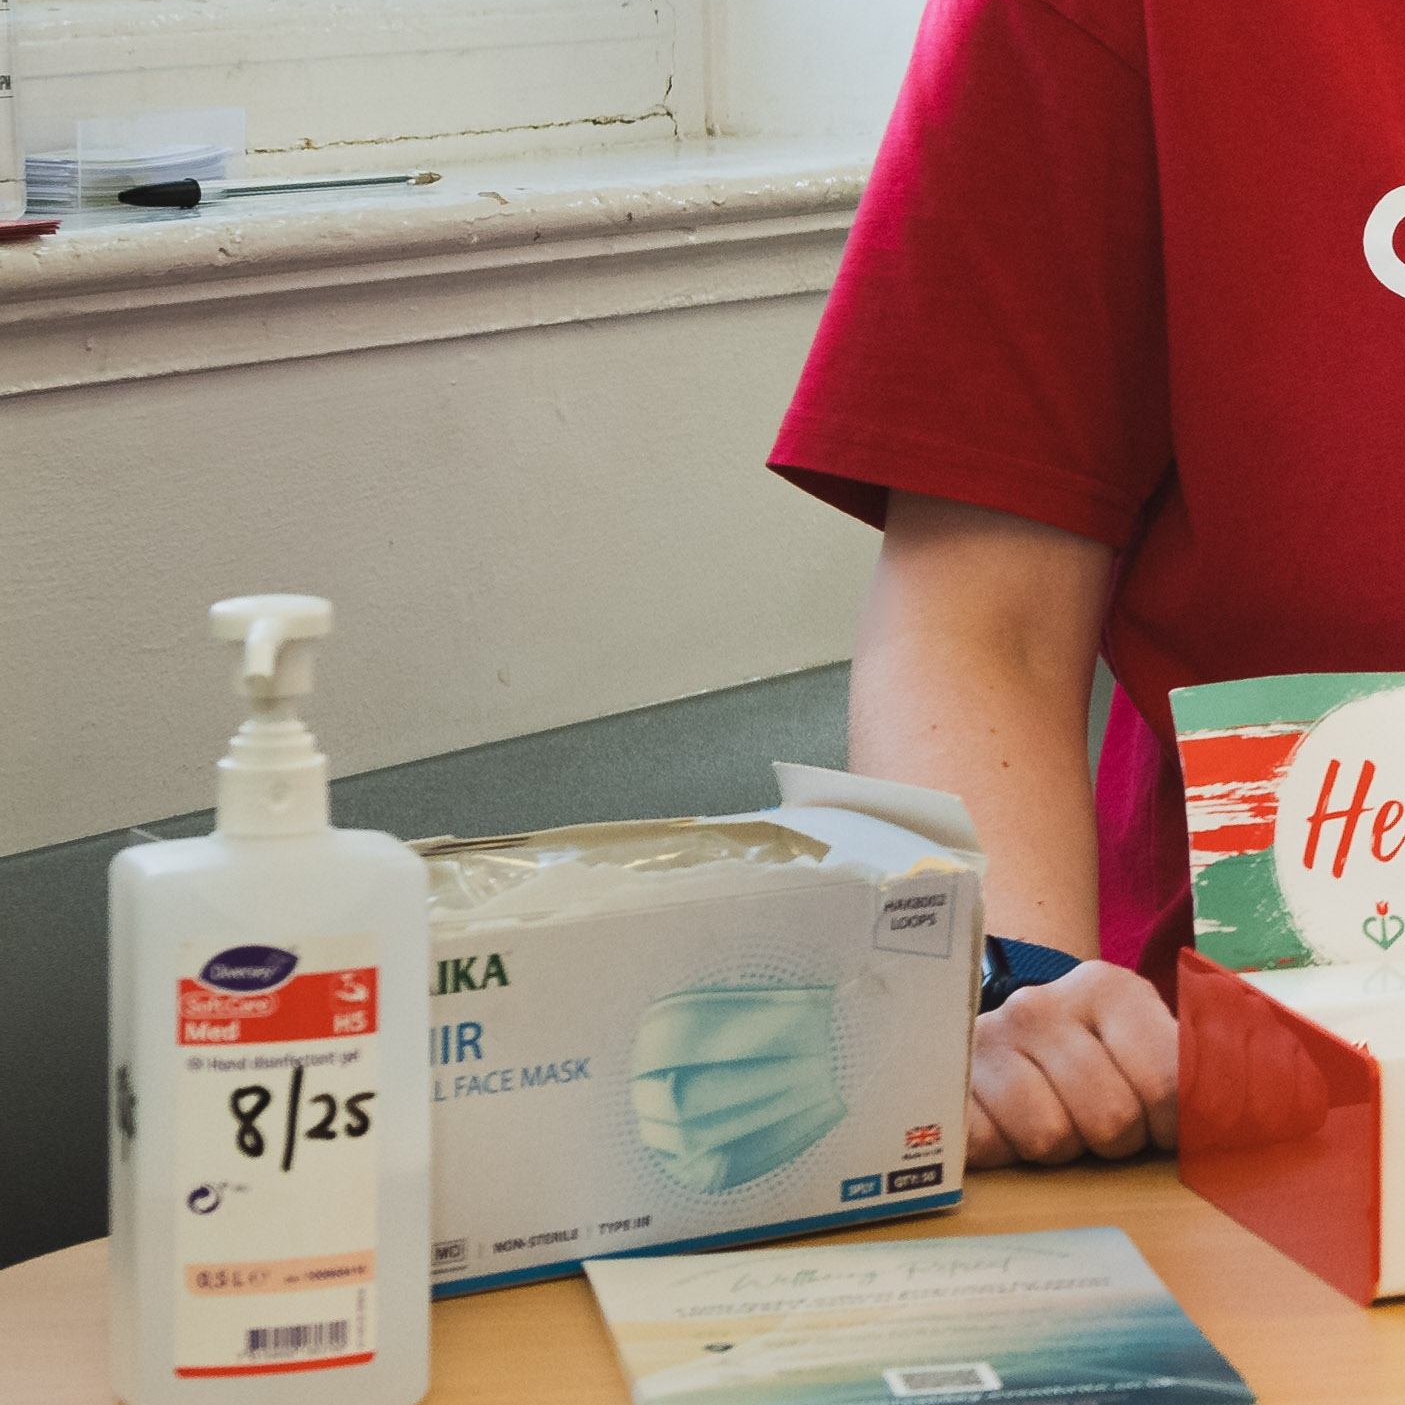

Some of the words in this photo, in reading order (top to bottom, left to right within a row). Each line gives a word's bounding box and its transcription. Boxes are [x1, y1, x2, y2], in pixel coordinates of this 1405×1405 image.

[890, 913, 937, 931] LOOPS
[429, 952, 511, 996] IKA
[184, 1020, 240, 1041] Med
[209, 1057, 247, 1072] Hand
[340, 1049, 361, 1066] gel
[453, 1068, 515, 1098] FACE
[520, 1056, 592, 1088] MASK
[230, 1064, 377, 1174] 8/25
[493, 1228, 579, 1254] NON-STERILE
[598, 1220, 631, 1236] TYPE
